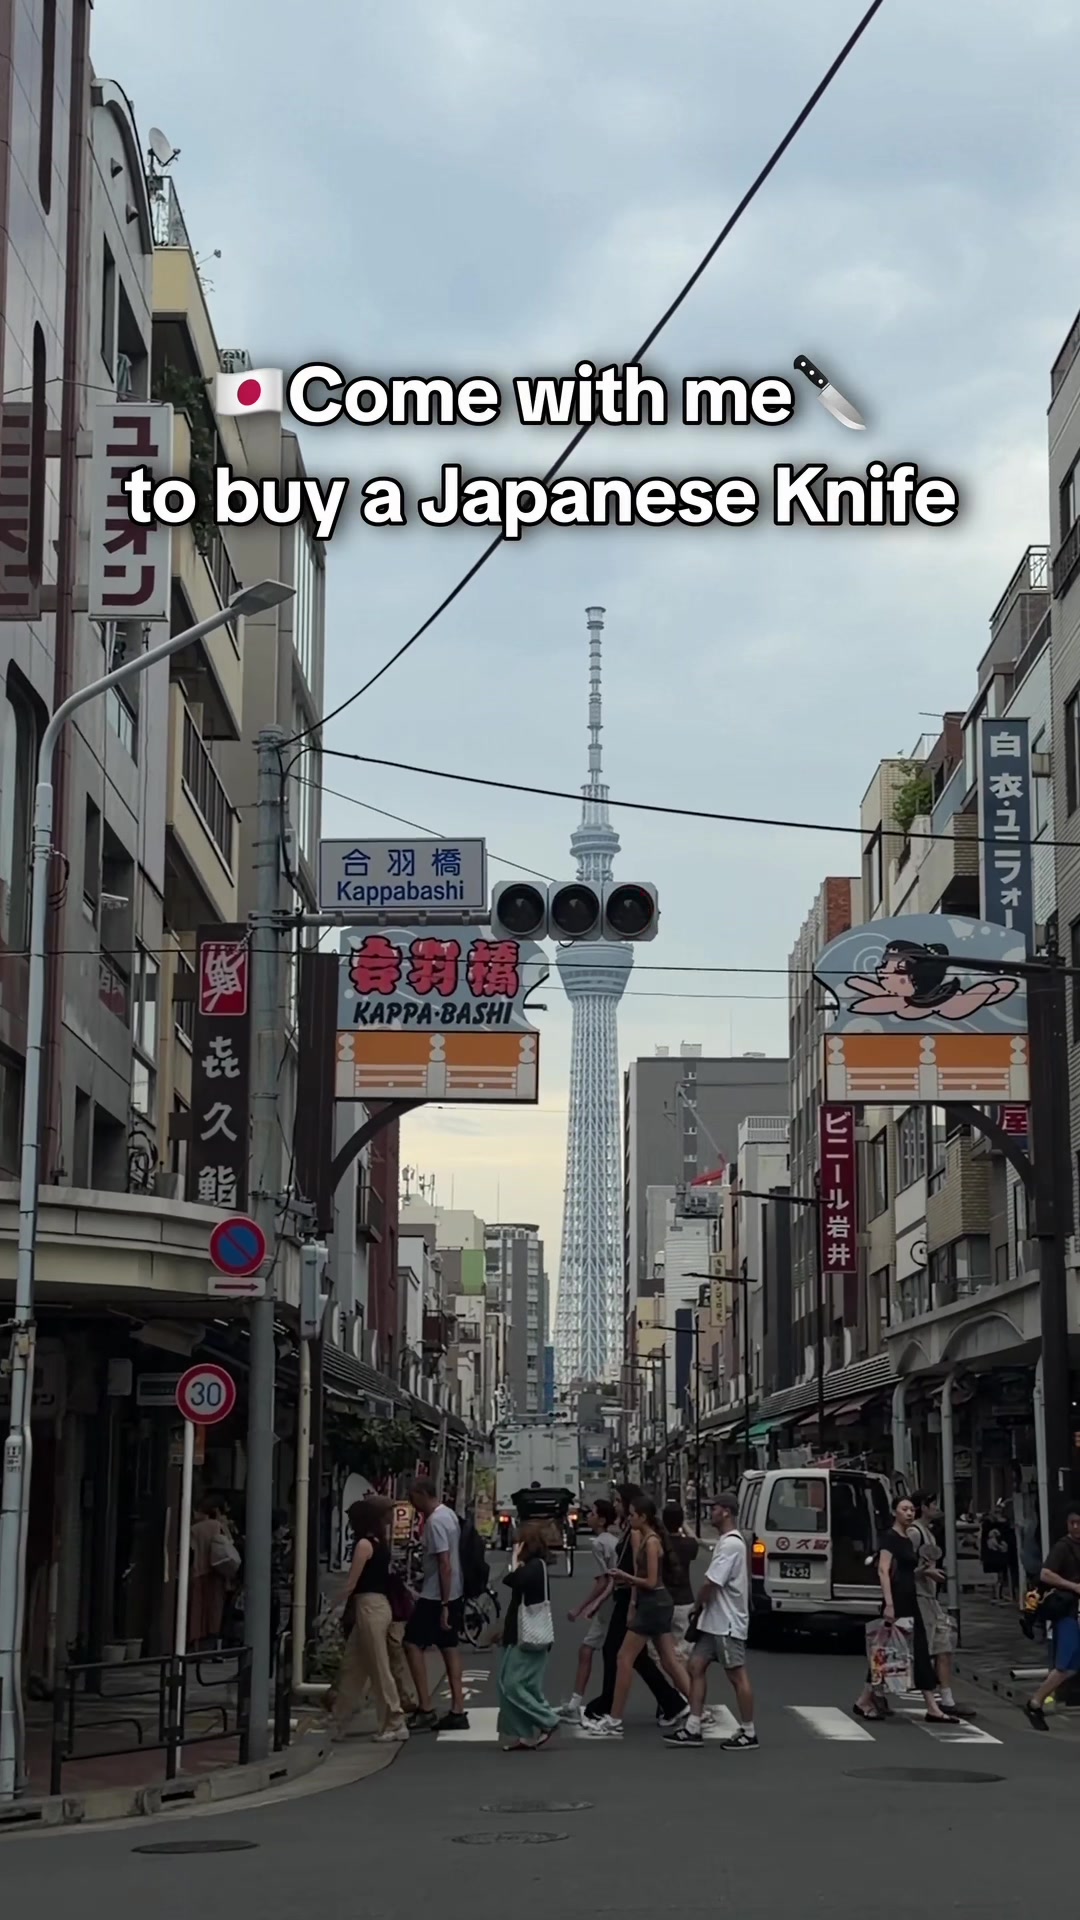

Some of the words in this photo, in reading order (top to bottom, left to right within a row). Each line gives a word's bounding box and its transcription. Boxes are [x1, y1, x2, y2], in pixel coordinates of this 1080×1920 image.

[341, 848, 462, 878] 合羽橋
[337, 880, 464, 906] Kappabashi
[350, 934, 521, 998] 合羽橋
[825, 1111, 851, 1267] ビニール岩井
[190, 1381, 222, 1407] 30
